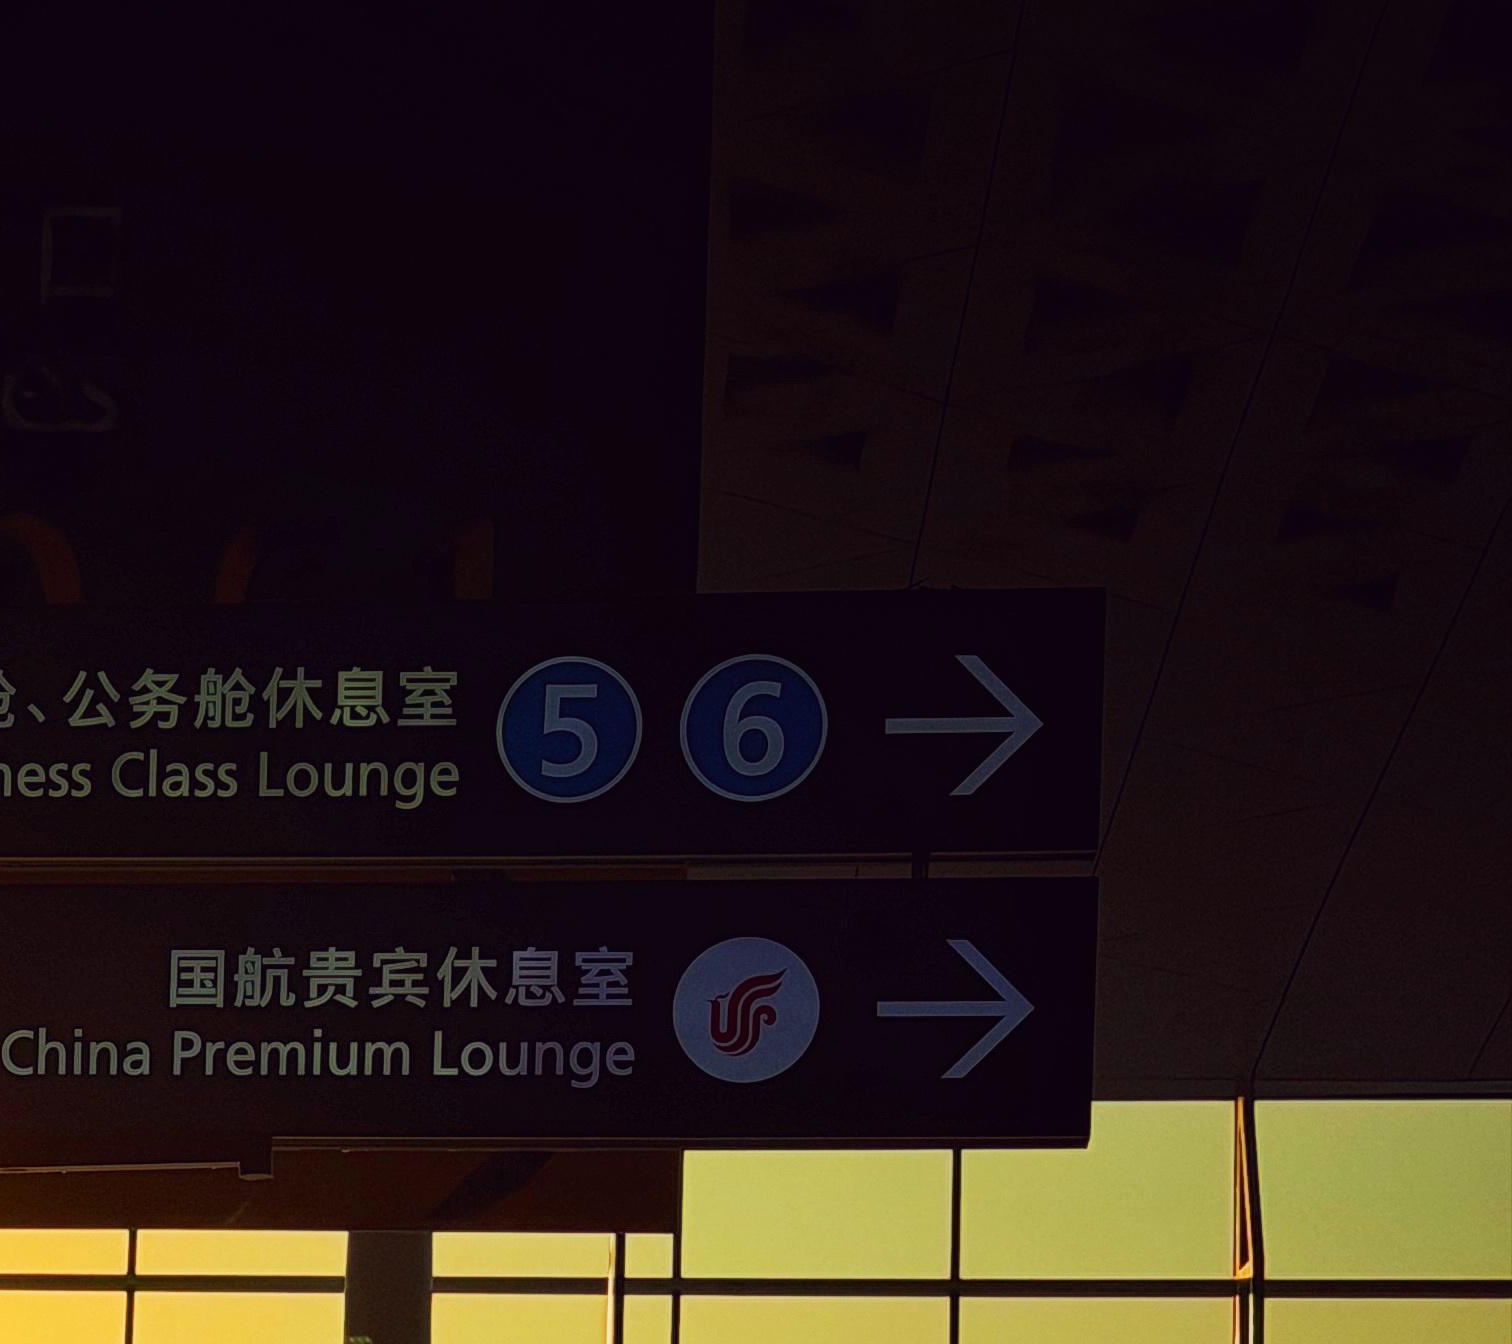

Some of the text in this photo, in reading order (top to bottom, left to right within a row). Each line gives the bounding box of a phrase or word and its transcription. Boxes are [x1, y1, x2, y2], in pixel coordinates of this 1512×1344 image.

[541, 680, 786, 778] 5 6
[110, 749, 239, 799] Class
[258, 750, 460, 810] Lounge
[169, 946, 634, 1009] 国航贵宾休息室
[1, 1027, 151, 1077] China
[172, 1028, 411, 1077] Premium
[433, 1029, 636, 1089] Lounge
